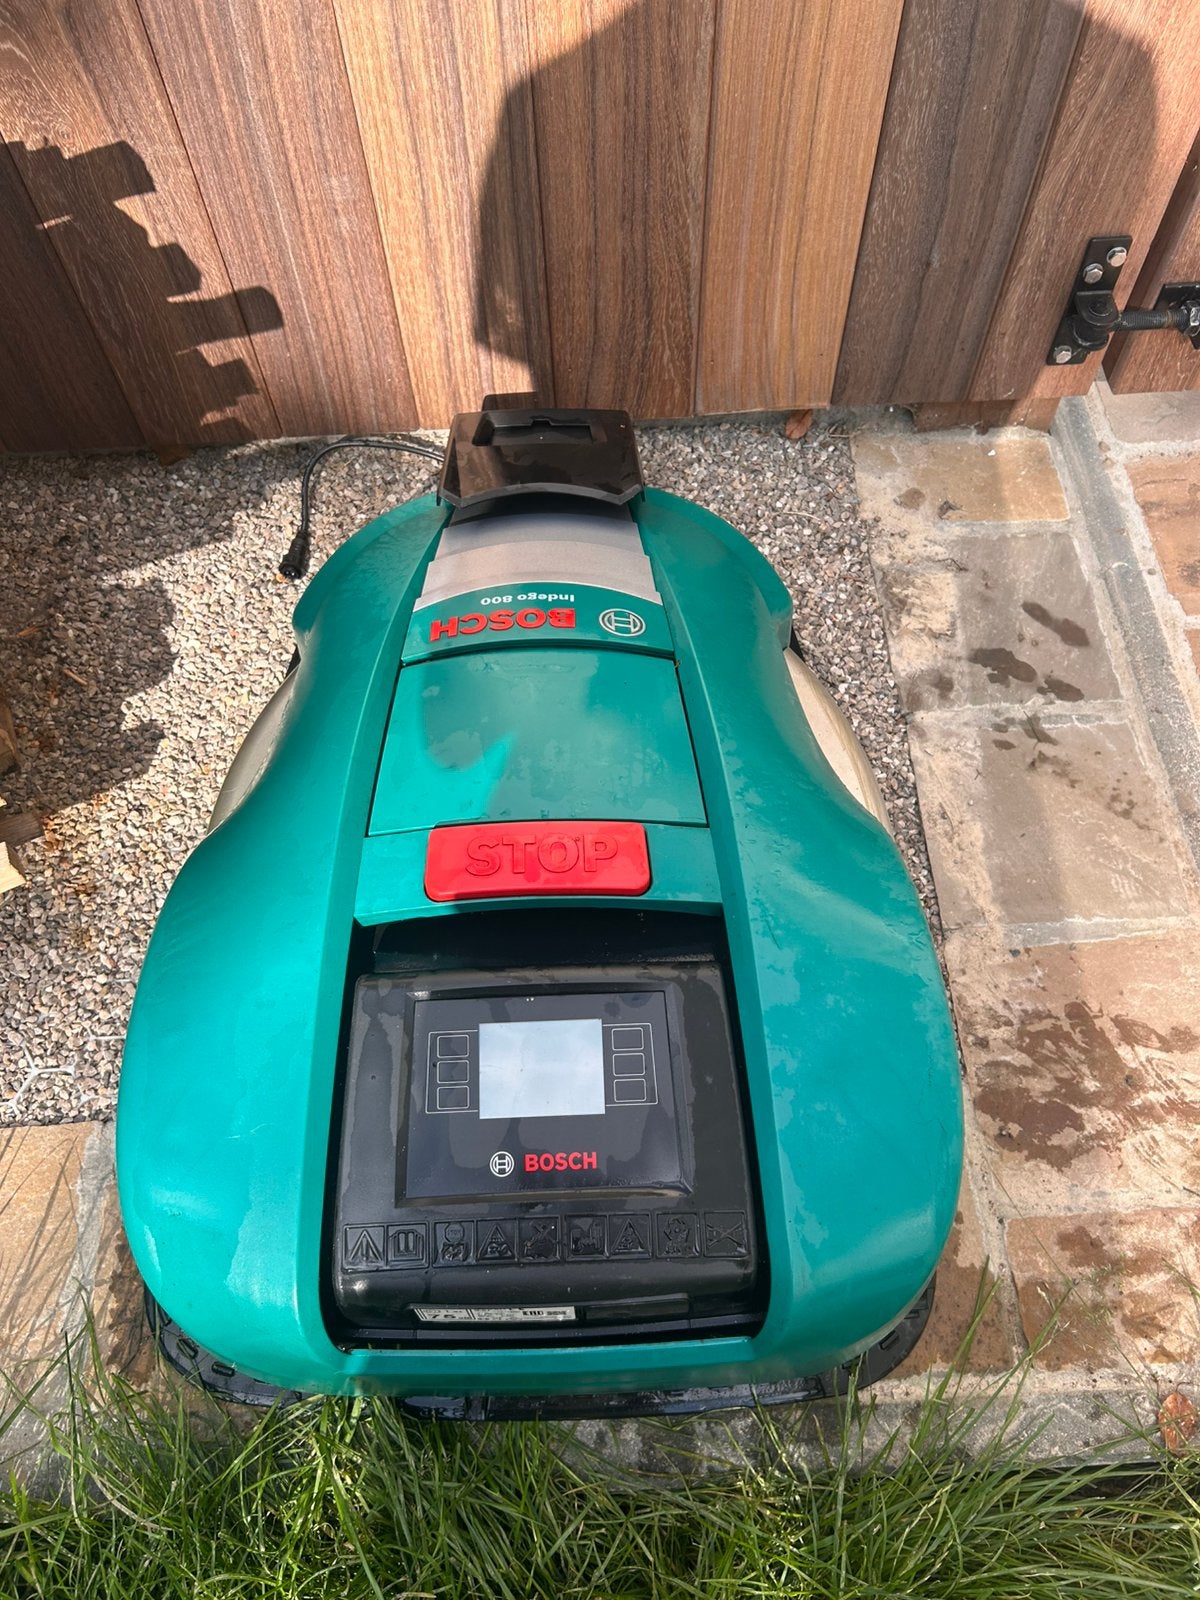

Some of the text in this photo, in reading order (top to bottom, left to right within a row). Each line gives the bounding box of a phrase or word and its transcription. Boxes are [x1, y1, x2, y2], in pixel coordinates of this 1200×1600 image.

[481, 592, 574, 606] Indego 800
[430, 607, 576, 641] BOSCH
[465, 833, 618, 877] STOP
[524, 1151, 598, 1173] BOSCH
